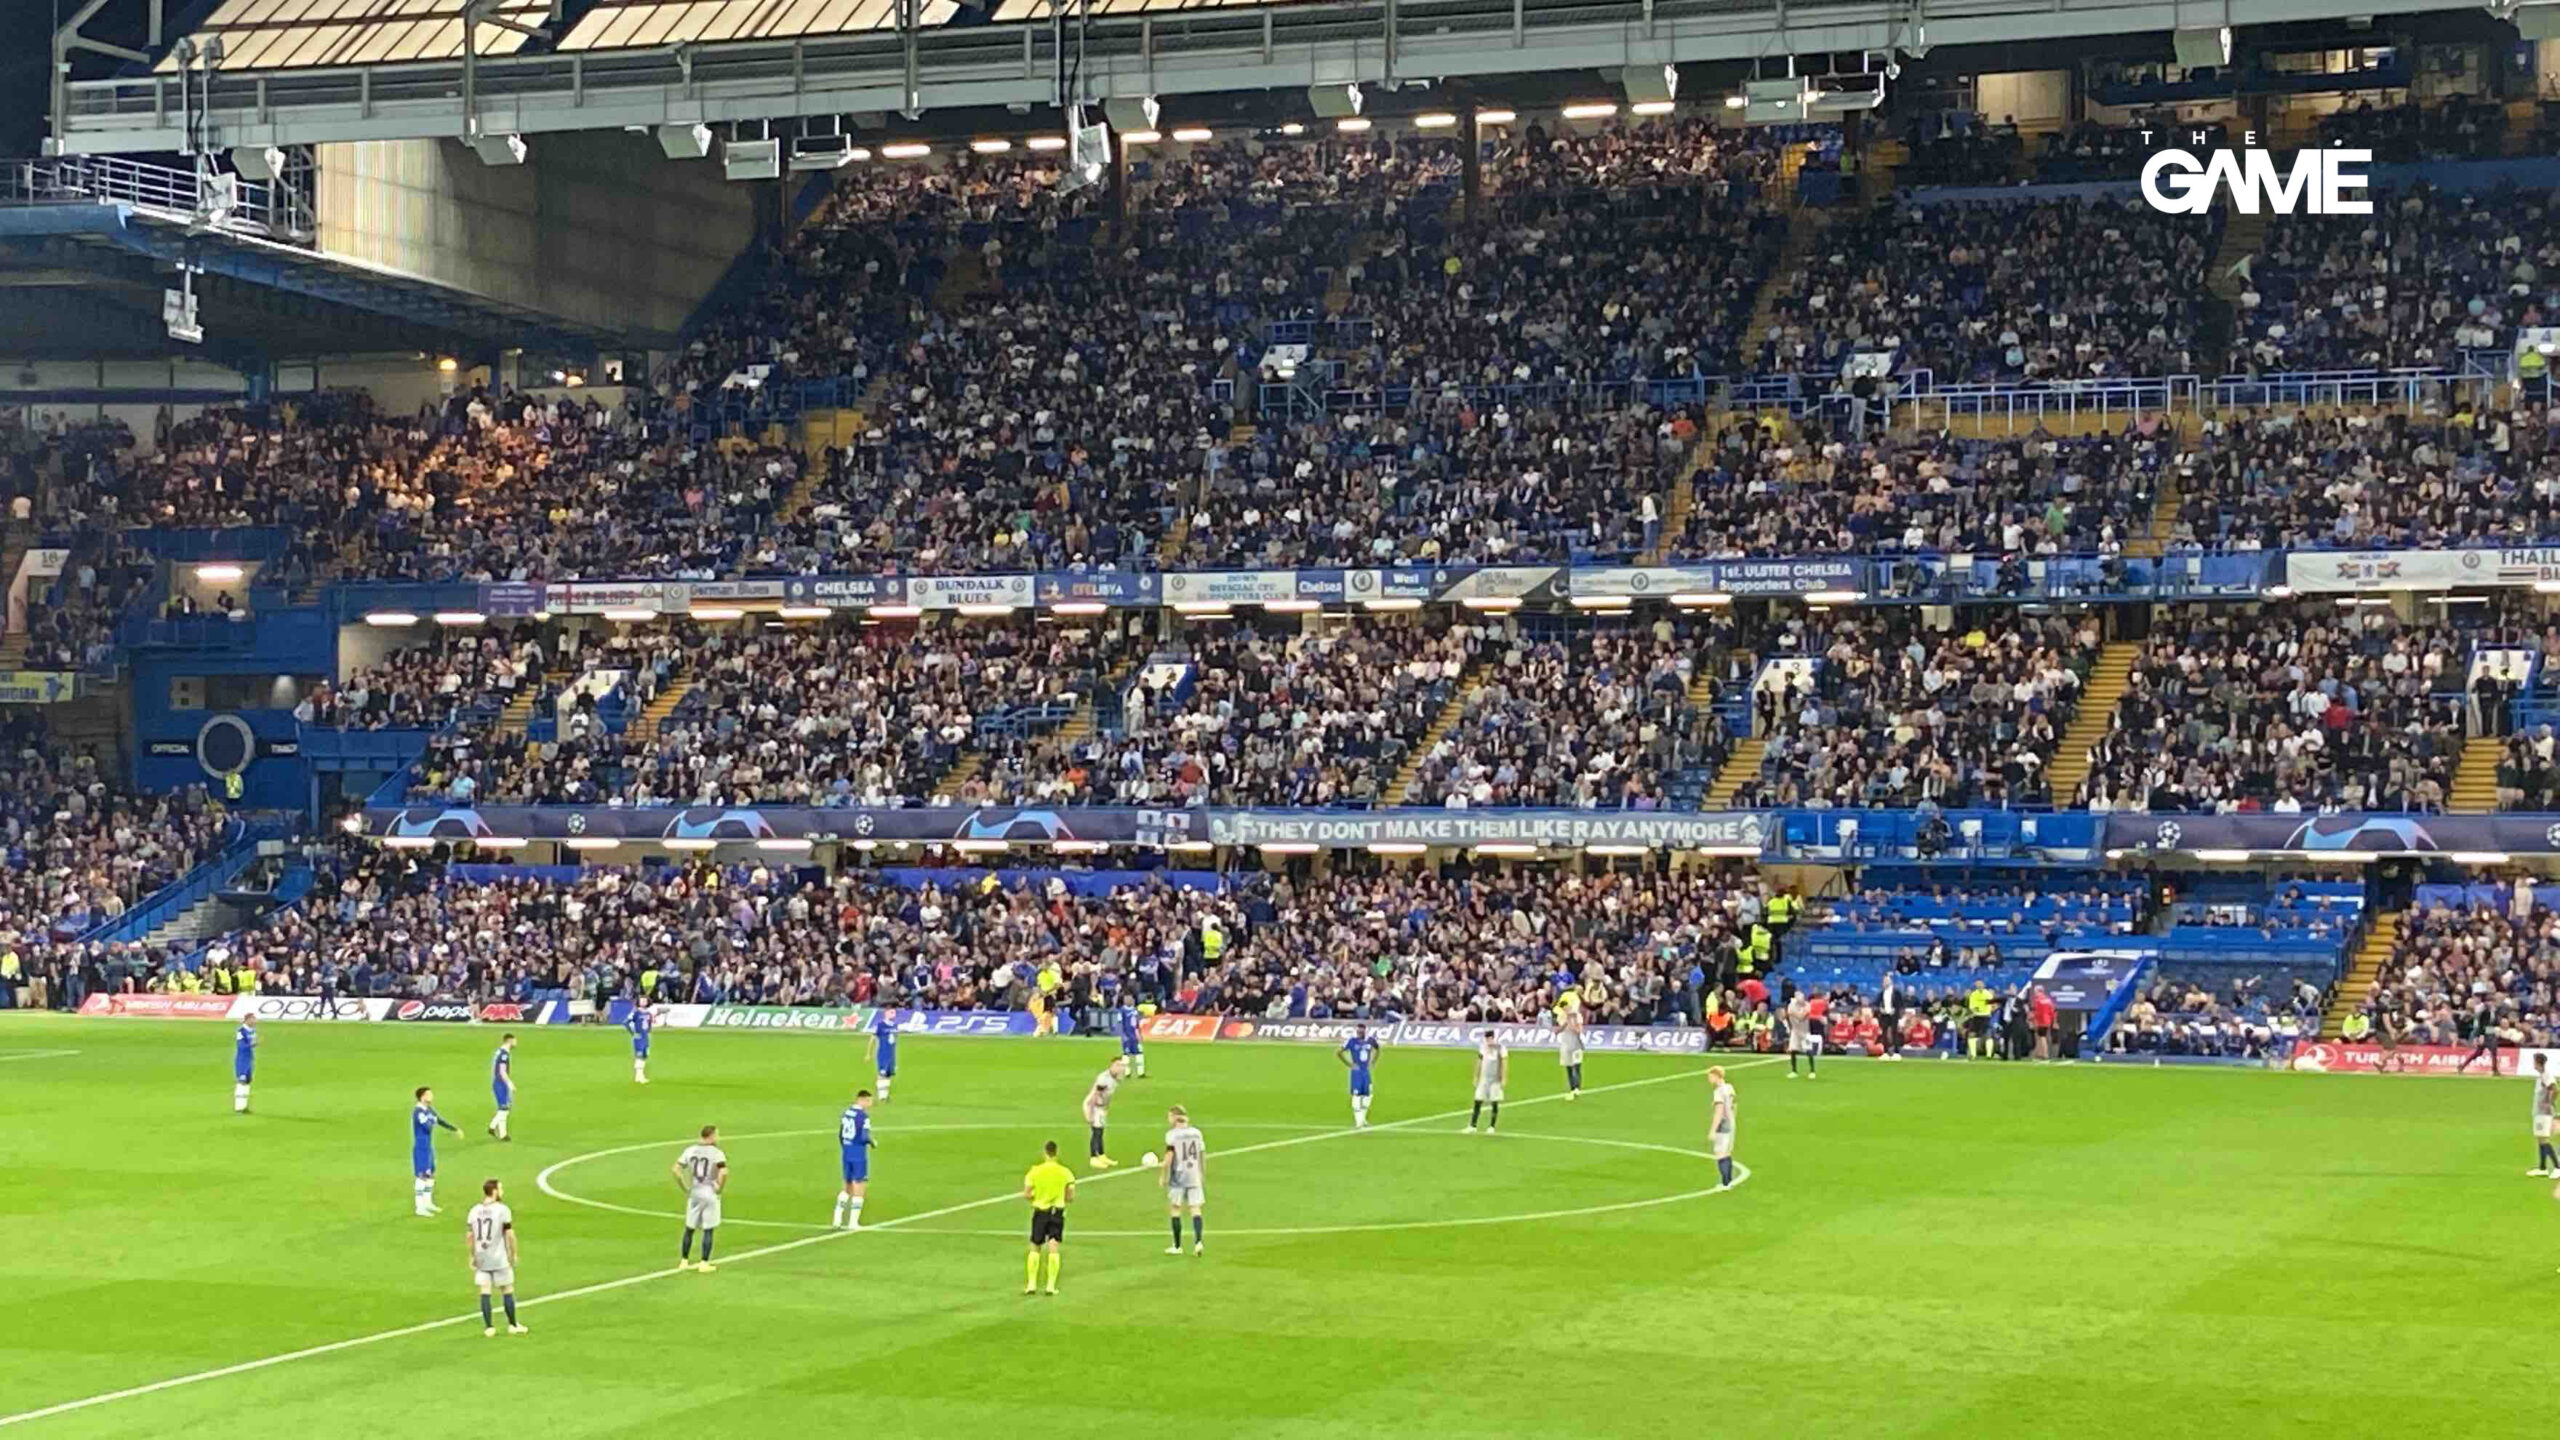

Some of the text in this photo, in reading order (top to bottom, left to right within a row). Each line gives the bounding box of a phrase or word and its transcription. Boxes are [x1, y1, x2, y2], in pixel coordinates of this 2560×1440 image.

[1285, 346, 1295, 359] 2
[1867, 355, 1877, 368] 3
[1744, 564, 1789, 577] ULSTER
[1793, 563, 1852, 576] CHELSEA
[814, 582, 875, 595] CHELSEA
[936, 580, 1004, 591] DUNDALK
[1299, 580, 1342, 593] Chelsea
[1719, 579, 1790, 593] Supporters
[1794, 578, 1827, 591] Club
[948, 593, 992, 604] BLUES
[1256, 821, 1314, 840] THEY
[1385, 820, 1452, 838] MAKE
[1455, 820, 1517, 838] THEM
[1520, 820, 1571, 838] LIKE
[1574, 820, 1622, 839] RAY
[1623, 820, 1739, 840] ANYMORE
[706, 1008, 837, 1027] Heineken
[1150, 1019, 1201, 1035] EAT
[1257, 1023, 1394, 1039] mastercrd
[1402, 1027, 1461, 1042] UEFA
[1611, 1031, 1701, 1047] LEAGUE
[1182, 1141, 1197, 1161] 14
[477, 1217, 493, 1242] 17
